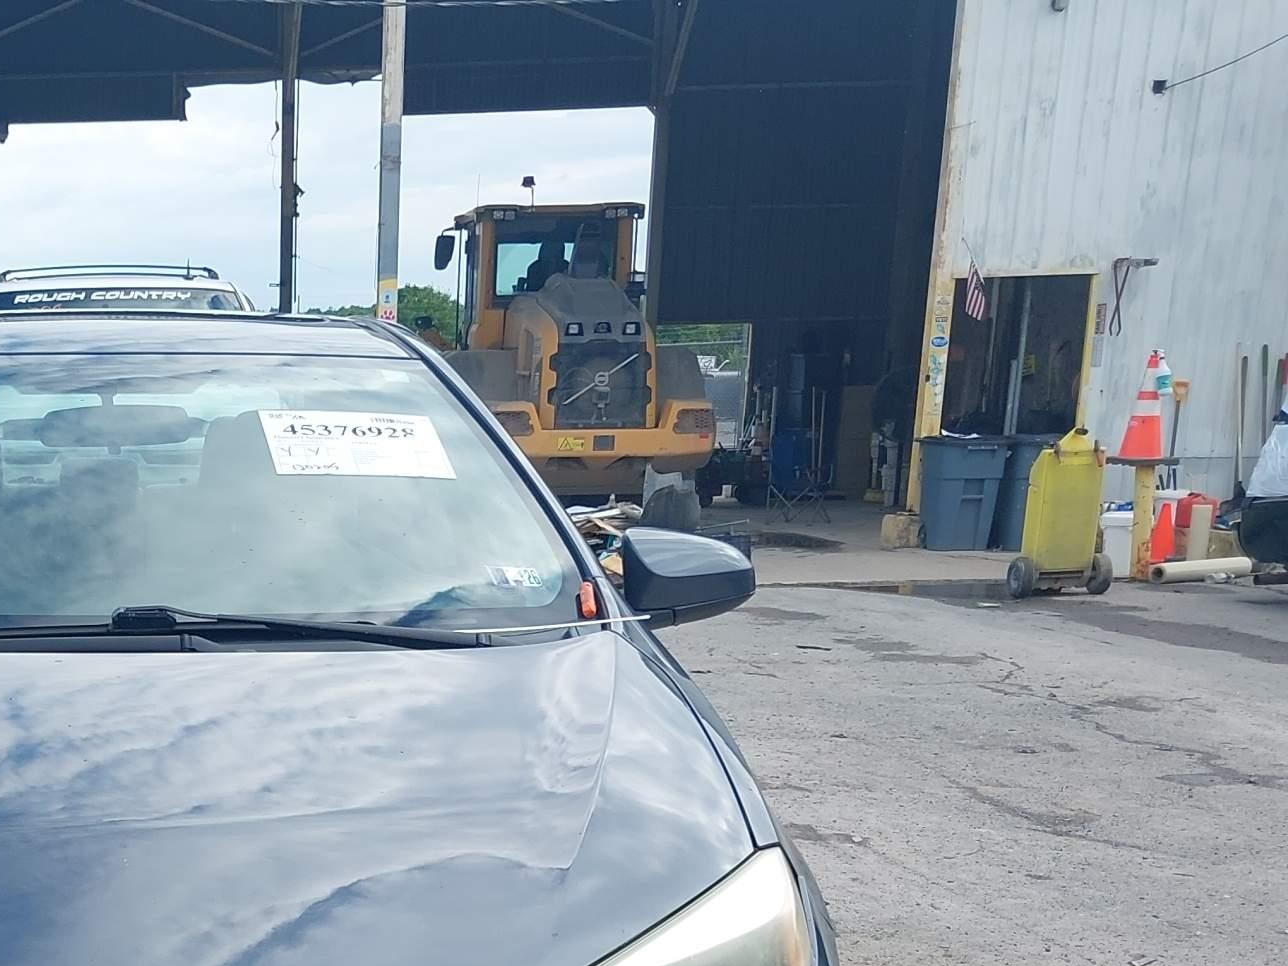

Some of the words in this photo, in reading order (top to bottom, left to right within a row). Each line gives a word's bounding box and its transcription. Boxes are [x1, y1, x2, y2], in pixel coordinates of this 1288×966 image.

[14, 291, 86, 305] ROUGH
[91, 290, 192, 301] COUNTRY
[282, 423, 415, 438] 45376928
